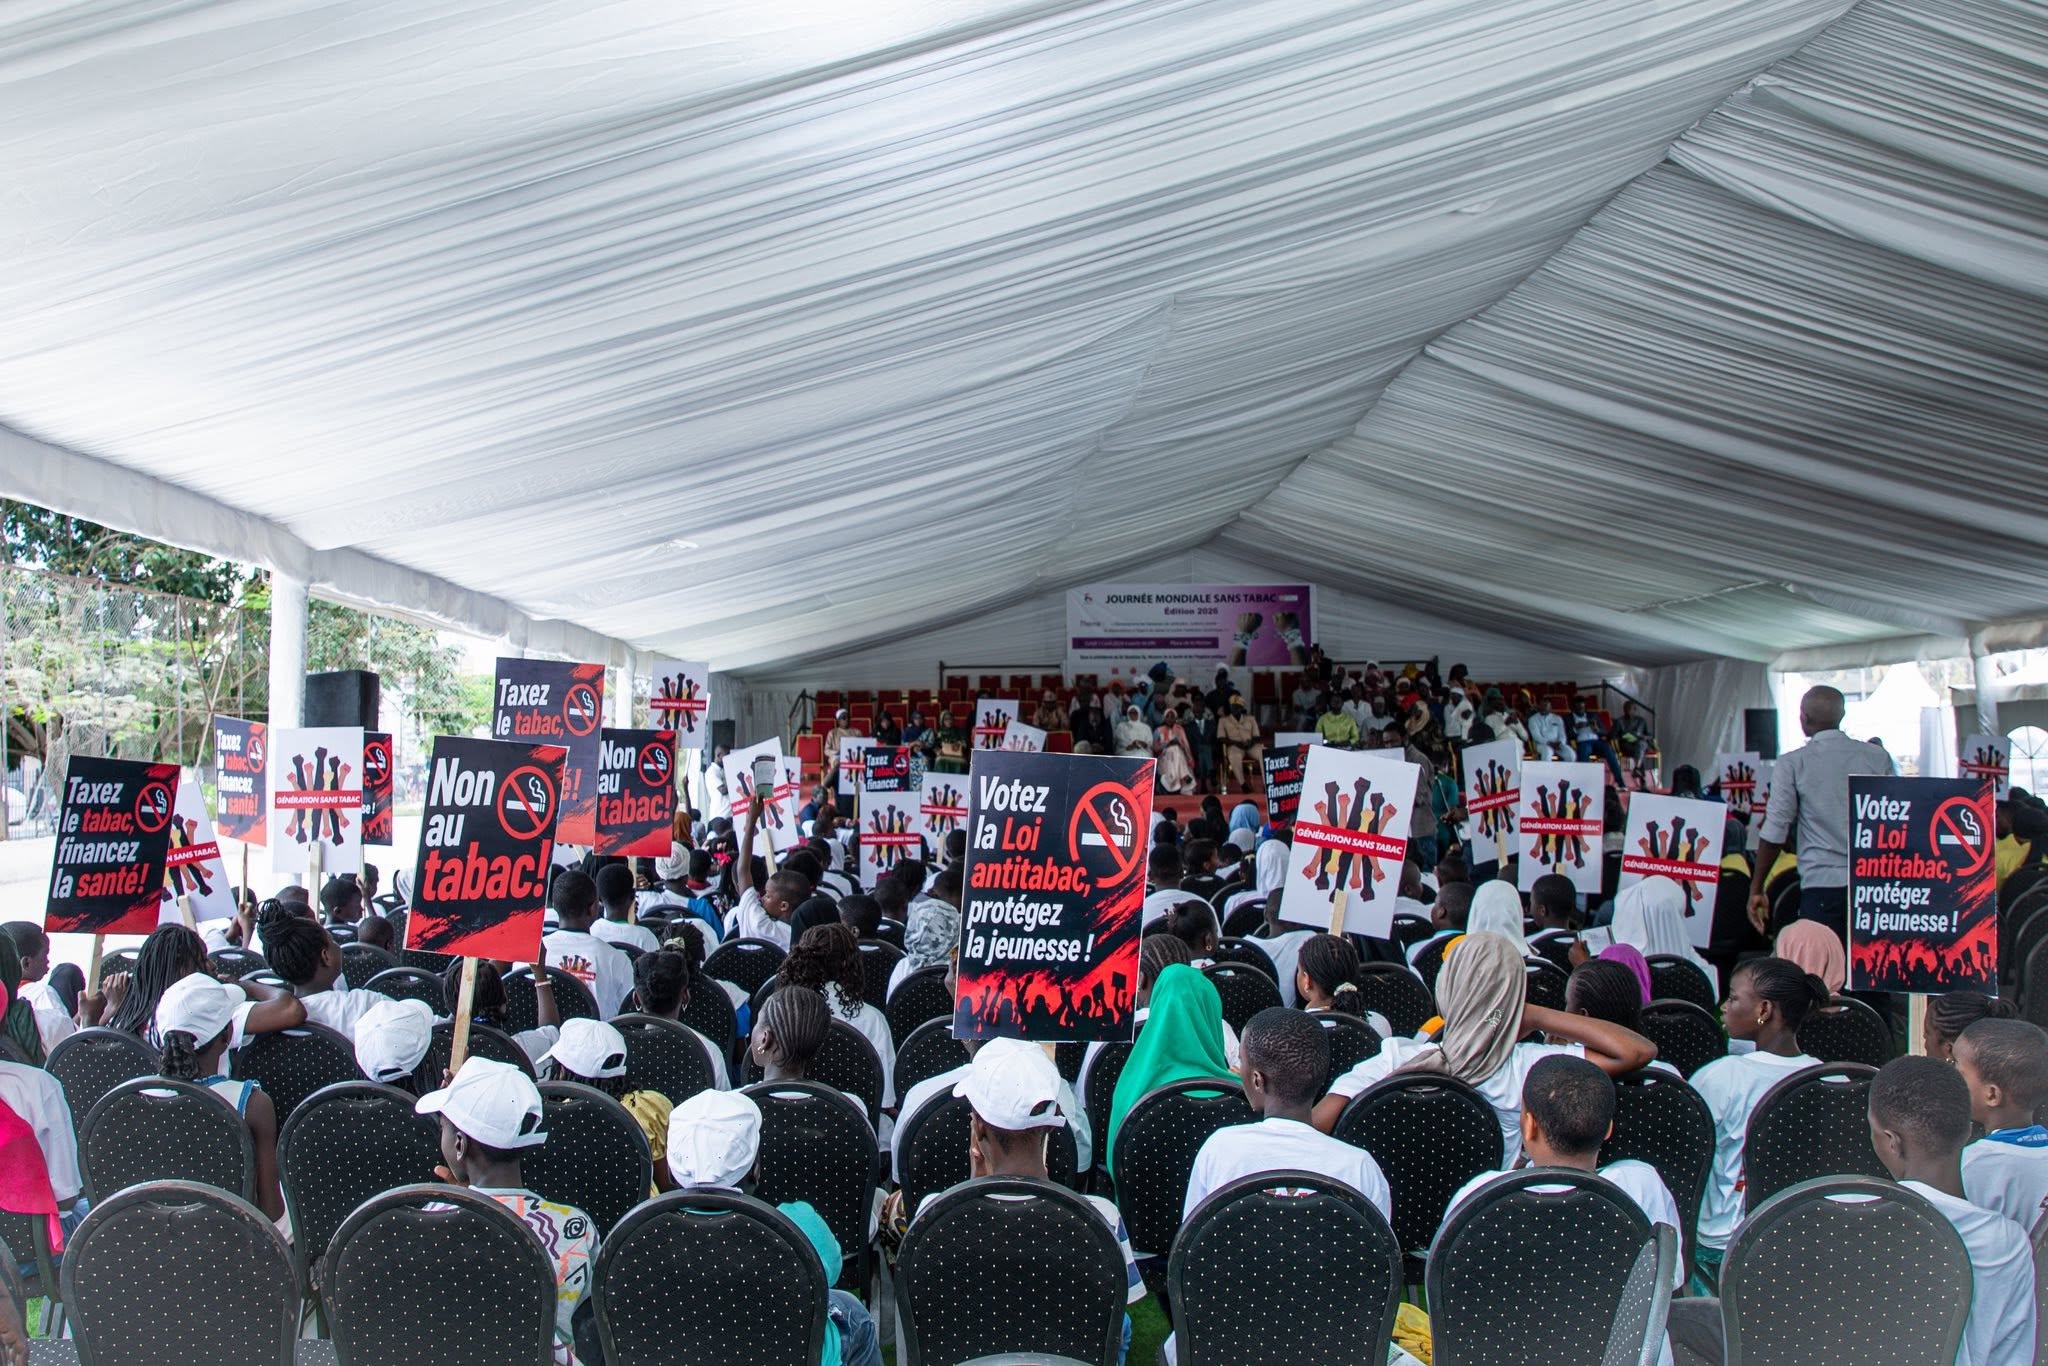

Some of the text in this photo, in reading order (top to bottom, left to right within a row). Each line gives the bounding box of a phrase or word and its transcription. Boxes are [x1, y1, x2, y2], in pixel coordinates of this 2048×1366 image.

[1105, 592, 1153, 604] JOURNÉE
[1156, 594, 1211, 604] MONDIALE
[1214, 594, 1241, 603] SANS
[1244, 594, 1277, 602] TABAC
[1164, 607, 1194, 615] Édition
[499, 678, 550, 706] Taxez
[496, 708, 564, 738] le tabac,
[217, 729, 241, 751] Taxez
[217, 751, 249, 773] le tabac,
[599, 740, 636, 770] Non
[866, 755, 888, 766] Taxez
[1264, 756, 1289, 771] Taxez
[218, 771, 253, 793] financez
[429, 758, 495, 807] Non
[599, 773, 620, 794] au
[866, 767, 873, 778] le
[867, 778, 898, 790] financez
[1266, 772, 1274, 784] le
[68, 776, 124, 804] Taxez
[218, 792, 258, 815] la santé!
[276, 795, 319, 804] GÉNÉRATION
[979, 776, 1049, 813] Votez
[1470, 792, 1520, 809] GÉNÉRATION SANS TABAC
[600, 785, 672, 825] tabac!
[1269, 800, 1279, 814] la
[1855, 794, 1911, 821] Votez
[61, 806, 135, 836] le tabac,
[425, 814, 465, 847] au
[974, 815, 1042, 851] la Loi
[1521, 821, 1562, 830] GÉNÉRATION
[1297, 827, 1403, 855] GÉNÉRATION SANS TABAC
[1854, 823, 1908, 849] la Loi
[58, 836, 140, 864] financez
[174, 850, 193, 861] SANS
[194, 847, 217, 858] TABAC
[52, 863, 149, 898] la santé!
[423, 839, 551, 901] tabac!
[970, 855, 1091, 898] antitabac,
[1624, 860, 1717, 878] GÉNÉRATION SANS TABAC
[1855, 852, 1952, 883] antitabac,
[1854, 881, 1931, 910] protégez
[966, 894, 1063, 932] protégez
[1855, 907, 1959, 935] la jeunesse !
[965, 929, 1094, 966] la jeunesse !
